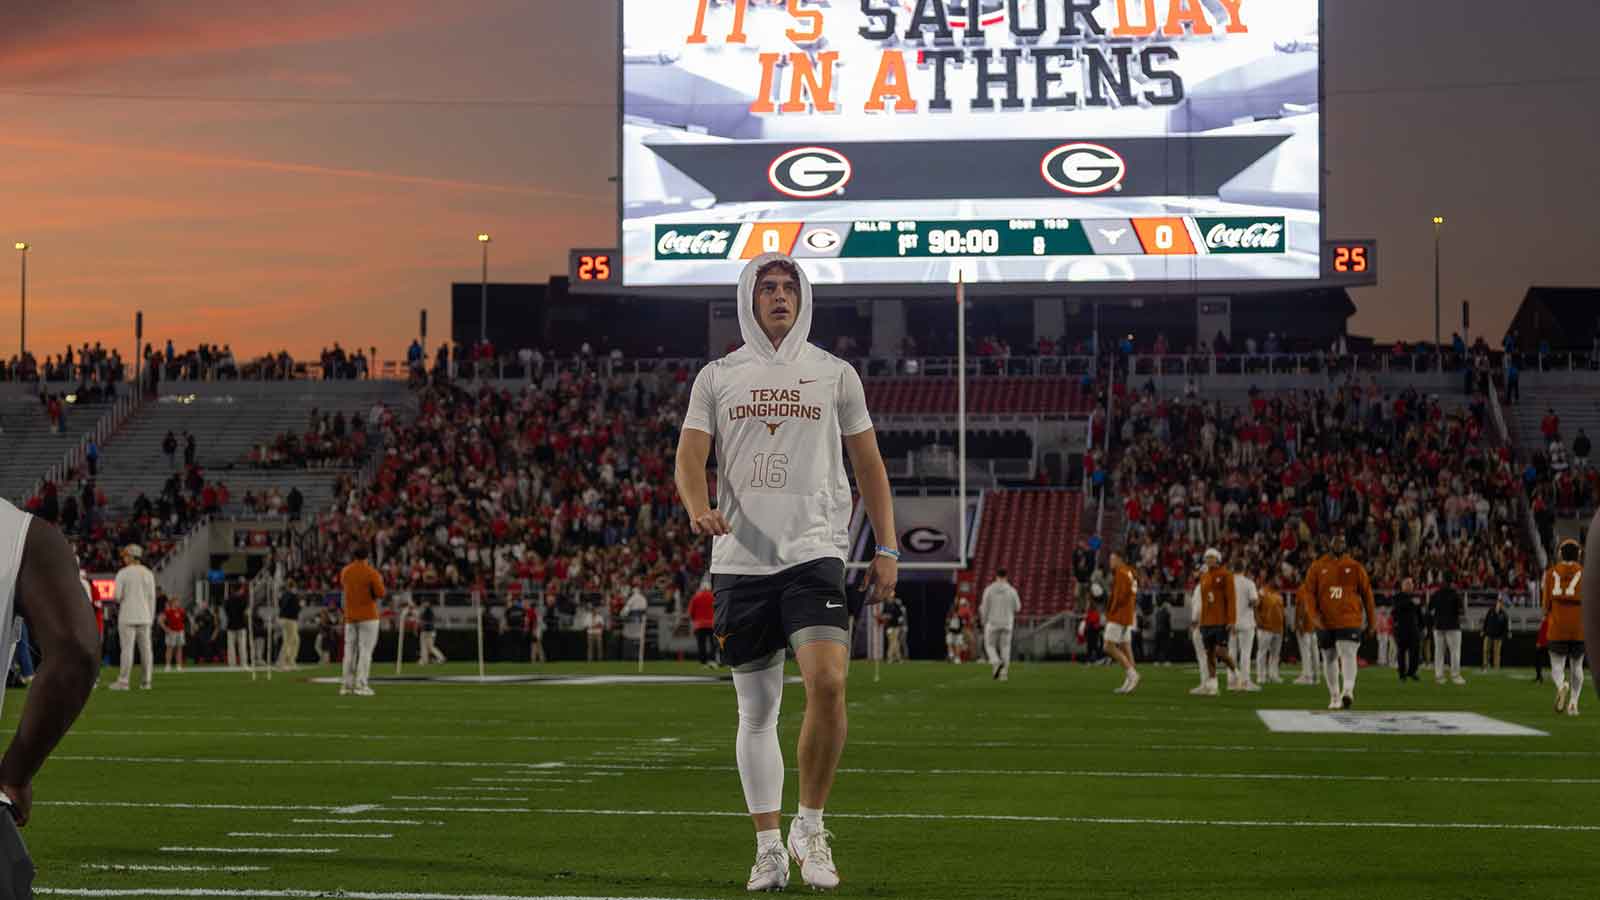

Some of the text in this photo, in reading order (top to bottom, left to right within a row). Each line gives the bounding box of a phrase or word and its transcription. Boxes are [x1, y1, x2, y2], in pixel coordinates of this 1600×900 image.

[687, 0, 1248, 44] ITS SATURDAY
[750, 46, 1184, 112] IN ATHENS
[771, 149, 848, 195] G
[1043, 145, 1122, 190] G
[657, 230, 730, 255] Coca-Cola
[762, 229, 780, 252] 0
[928, 229, 999, 254] 90:00
[1155, 225, 1173, 249] 0
[1206, 222, 1283, 249] Coca-Cola
[578, 255, 609, 281] 25
[1334, 246, 1366, 273] 25
[750, 389, 801, 402] TEXAS
[729, 403, 822, 421] LONGHORNS
[751, 453, 788, 488] 16
